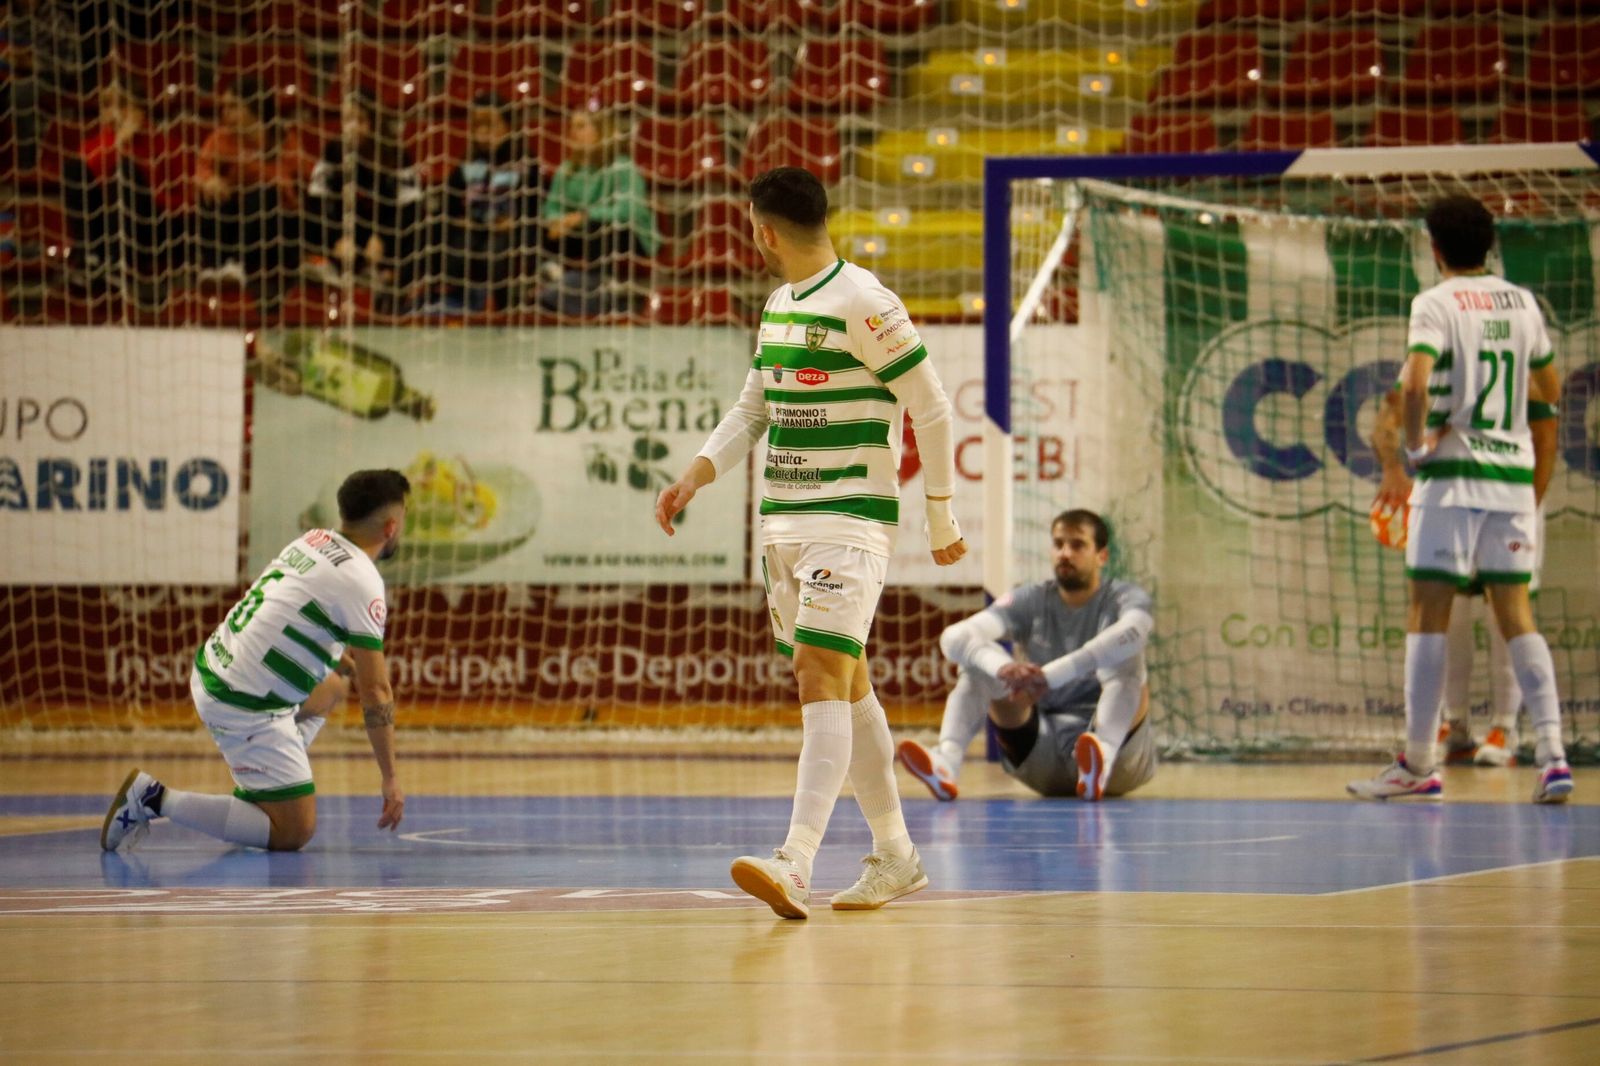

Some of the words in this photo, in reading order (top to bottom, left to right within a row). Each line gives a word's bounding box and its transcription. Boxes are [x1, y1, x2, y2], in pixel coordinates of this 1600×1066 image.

[536, 357, 720, 433] Baena
[592, 347, 669, 393] Peña
[1471, 350, 1514, 430] 21
[1220, 613, 1295, 649] Con
[1309, 613, 1341, 649] el
[386, 648, 526, 696] nicipal
[541, 647, 597, 686] de
[614, 646, 796, 696] Deporte
